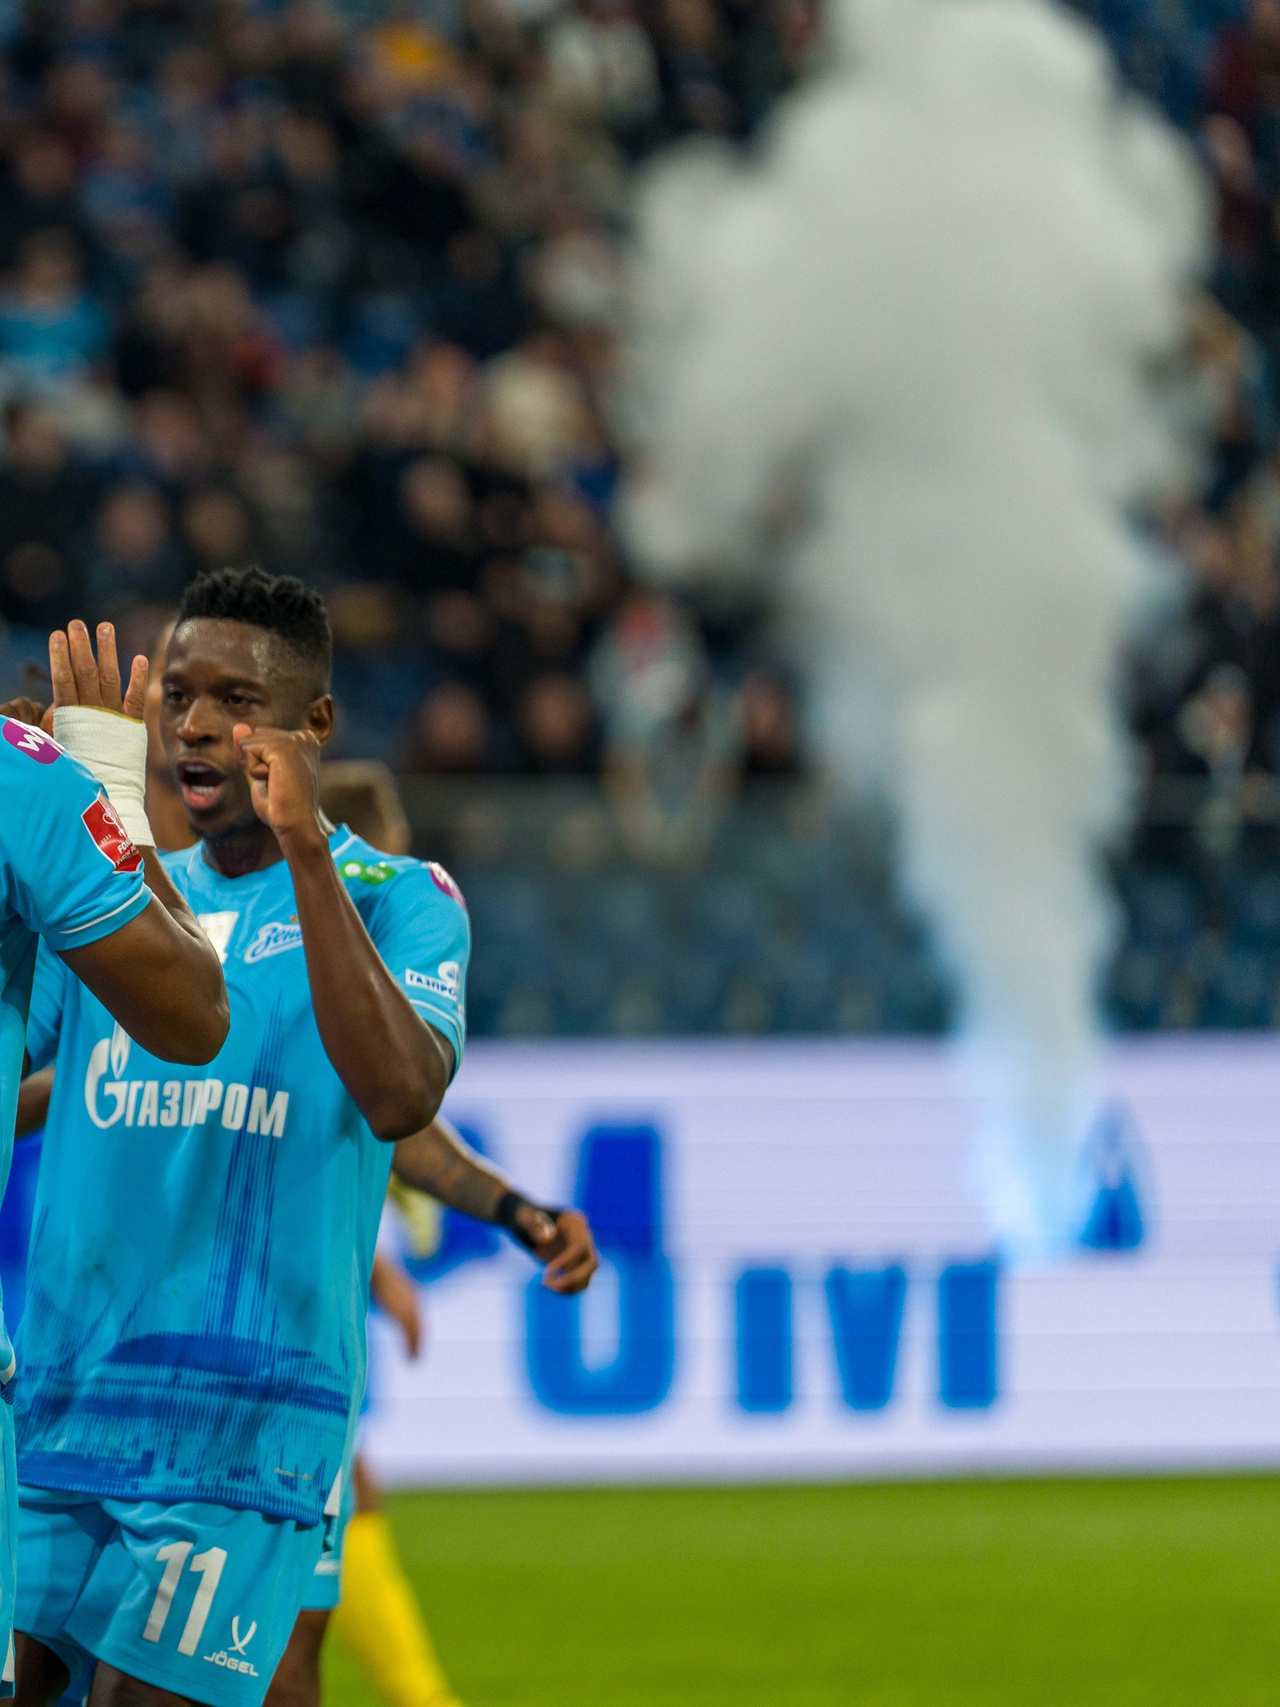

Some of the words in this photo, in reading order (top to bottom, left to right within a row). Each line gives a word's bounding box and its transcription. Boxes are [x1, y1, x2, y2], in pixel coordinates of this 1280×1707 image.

[408, 972, 458, 997] ГАЗПРО
[125, 1078, 290, 1139] ГАЗПРОМ
[143, 1540, 228, 1657] 11
[203, 1650, 259, 1677] JÖGEL
